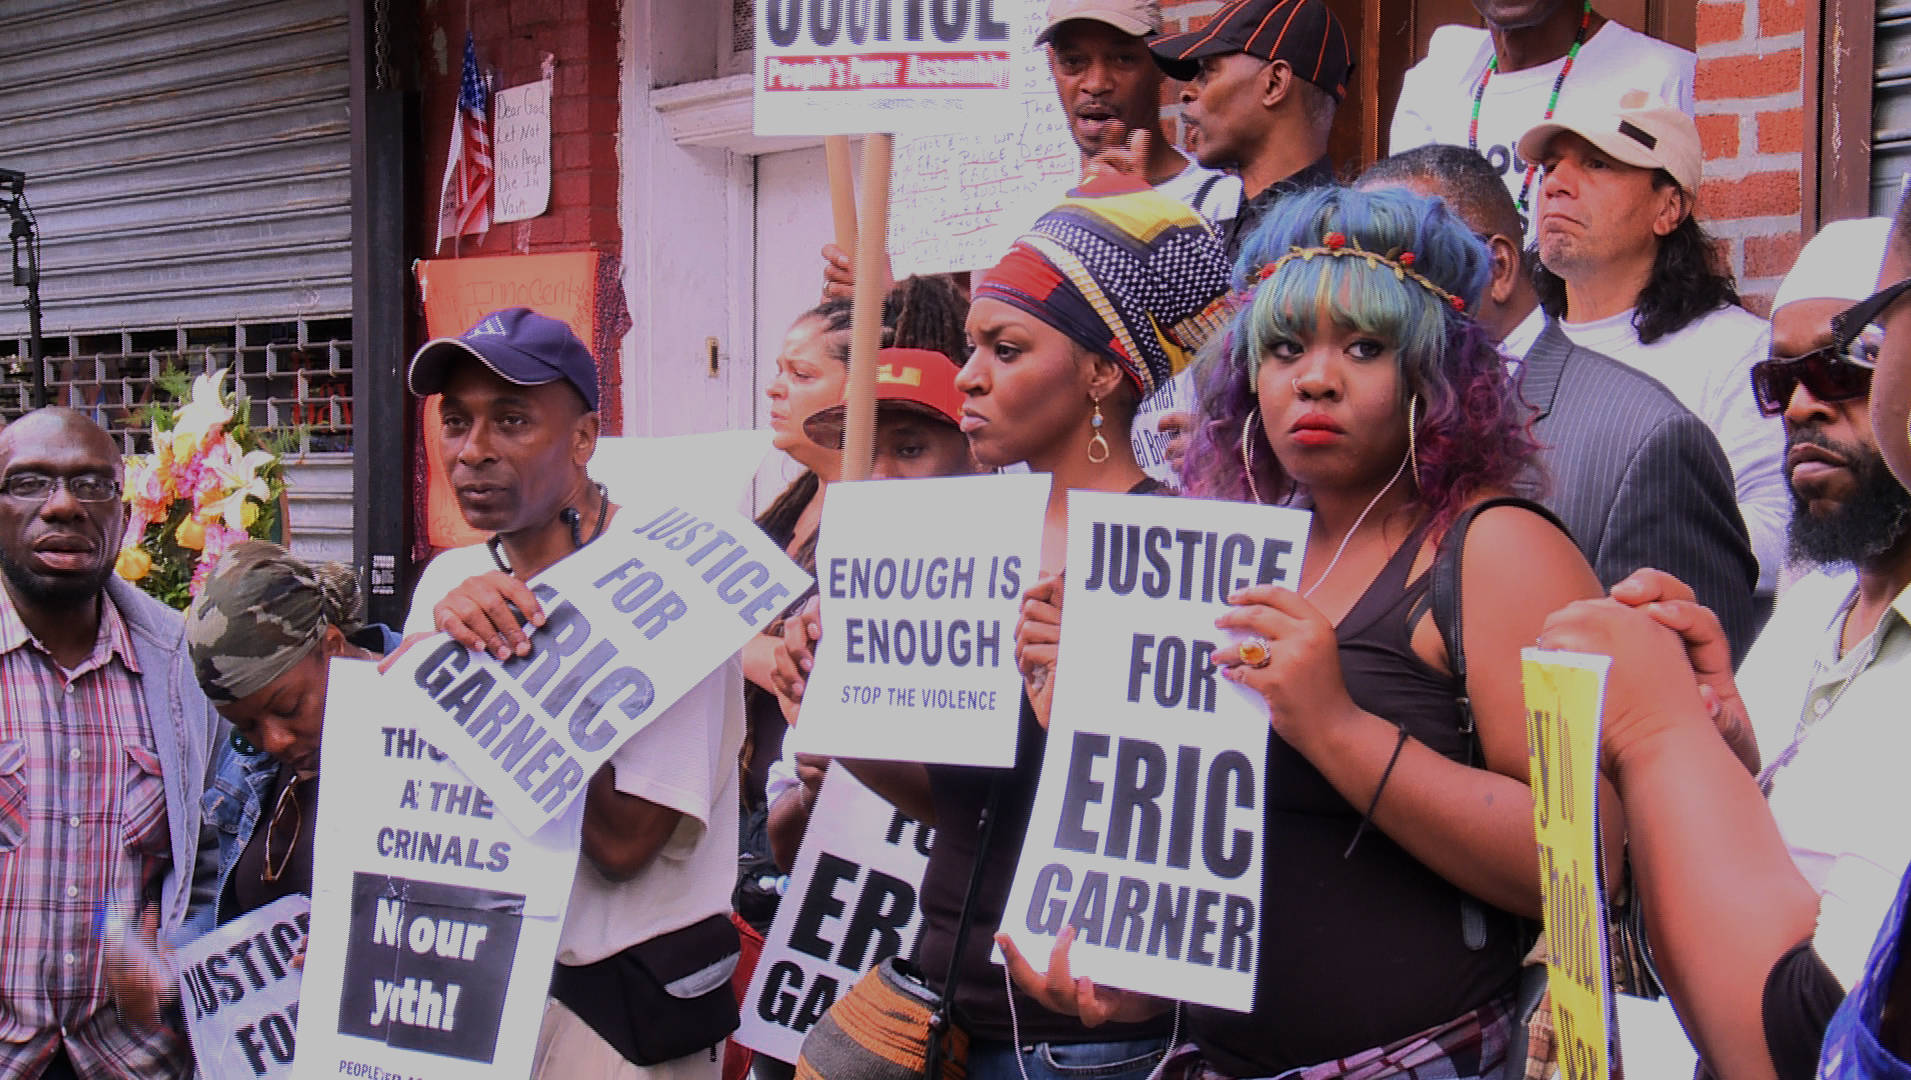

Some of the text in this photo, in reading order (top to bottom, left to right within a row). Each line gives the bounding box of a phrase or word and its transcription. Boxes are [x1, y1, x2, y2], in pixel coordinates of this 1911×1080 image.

[768, 57, 845, 91] People's
[632, 506, 790, 627] JUSTICE
[829, 555, 1022, 600] ENOUGH IS
[1085, 521, 1293, 607] JUSTICE
[592, 557, 688, 640] FOR
[846, 618, 1000, 668] ENOUGH
[1127, 632, 1218, 714] FOR
[414, 639, 584, 815] GARNER
[841, 685, 997, 711] STOP THE VIOLENCE
[430, 781, 494, 821] THE
[1053, 730, 1256, 880] ERIC
[376, 826, 512, 873] CRINALS
[408, 915, 488, 962] our
[1025, 863, 1256, 974] GARNER
[370, 976, 461, 1032] yth!
[234, 1000, 299, 1079] FO
